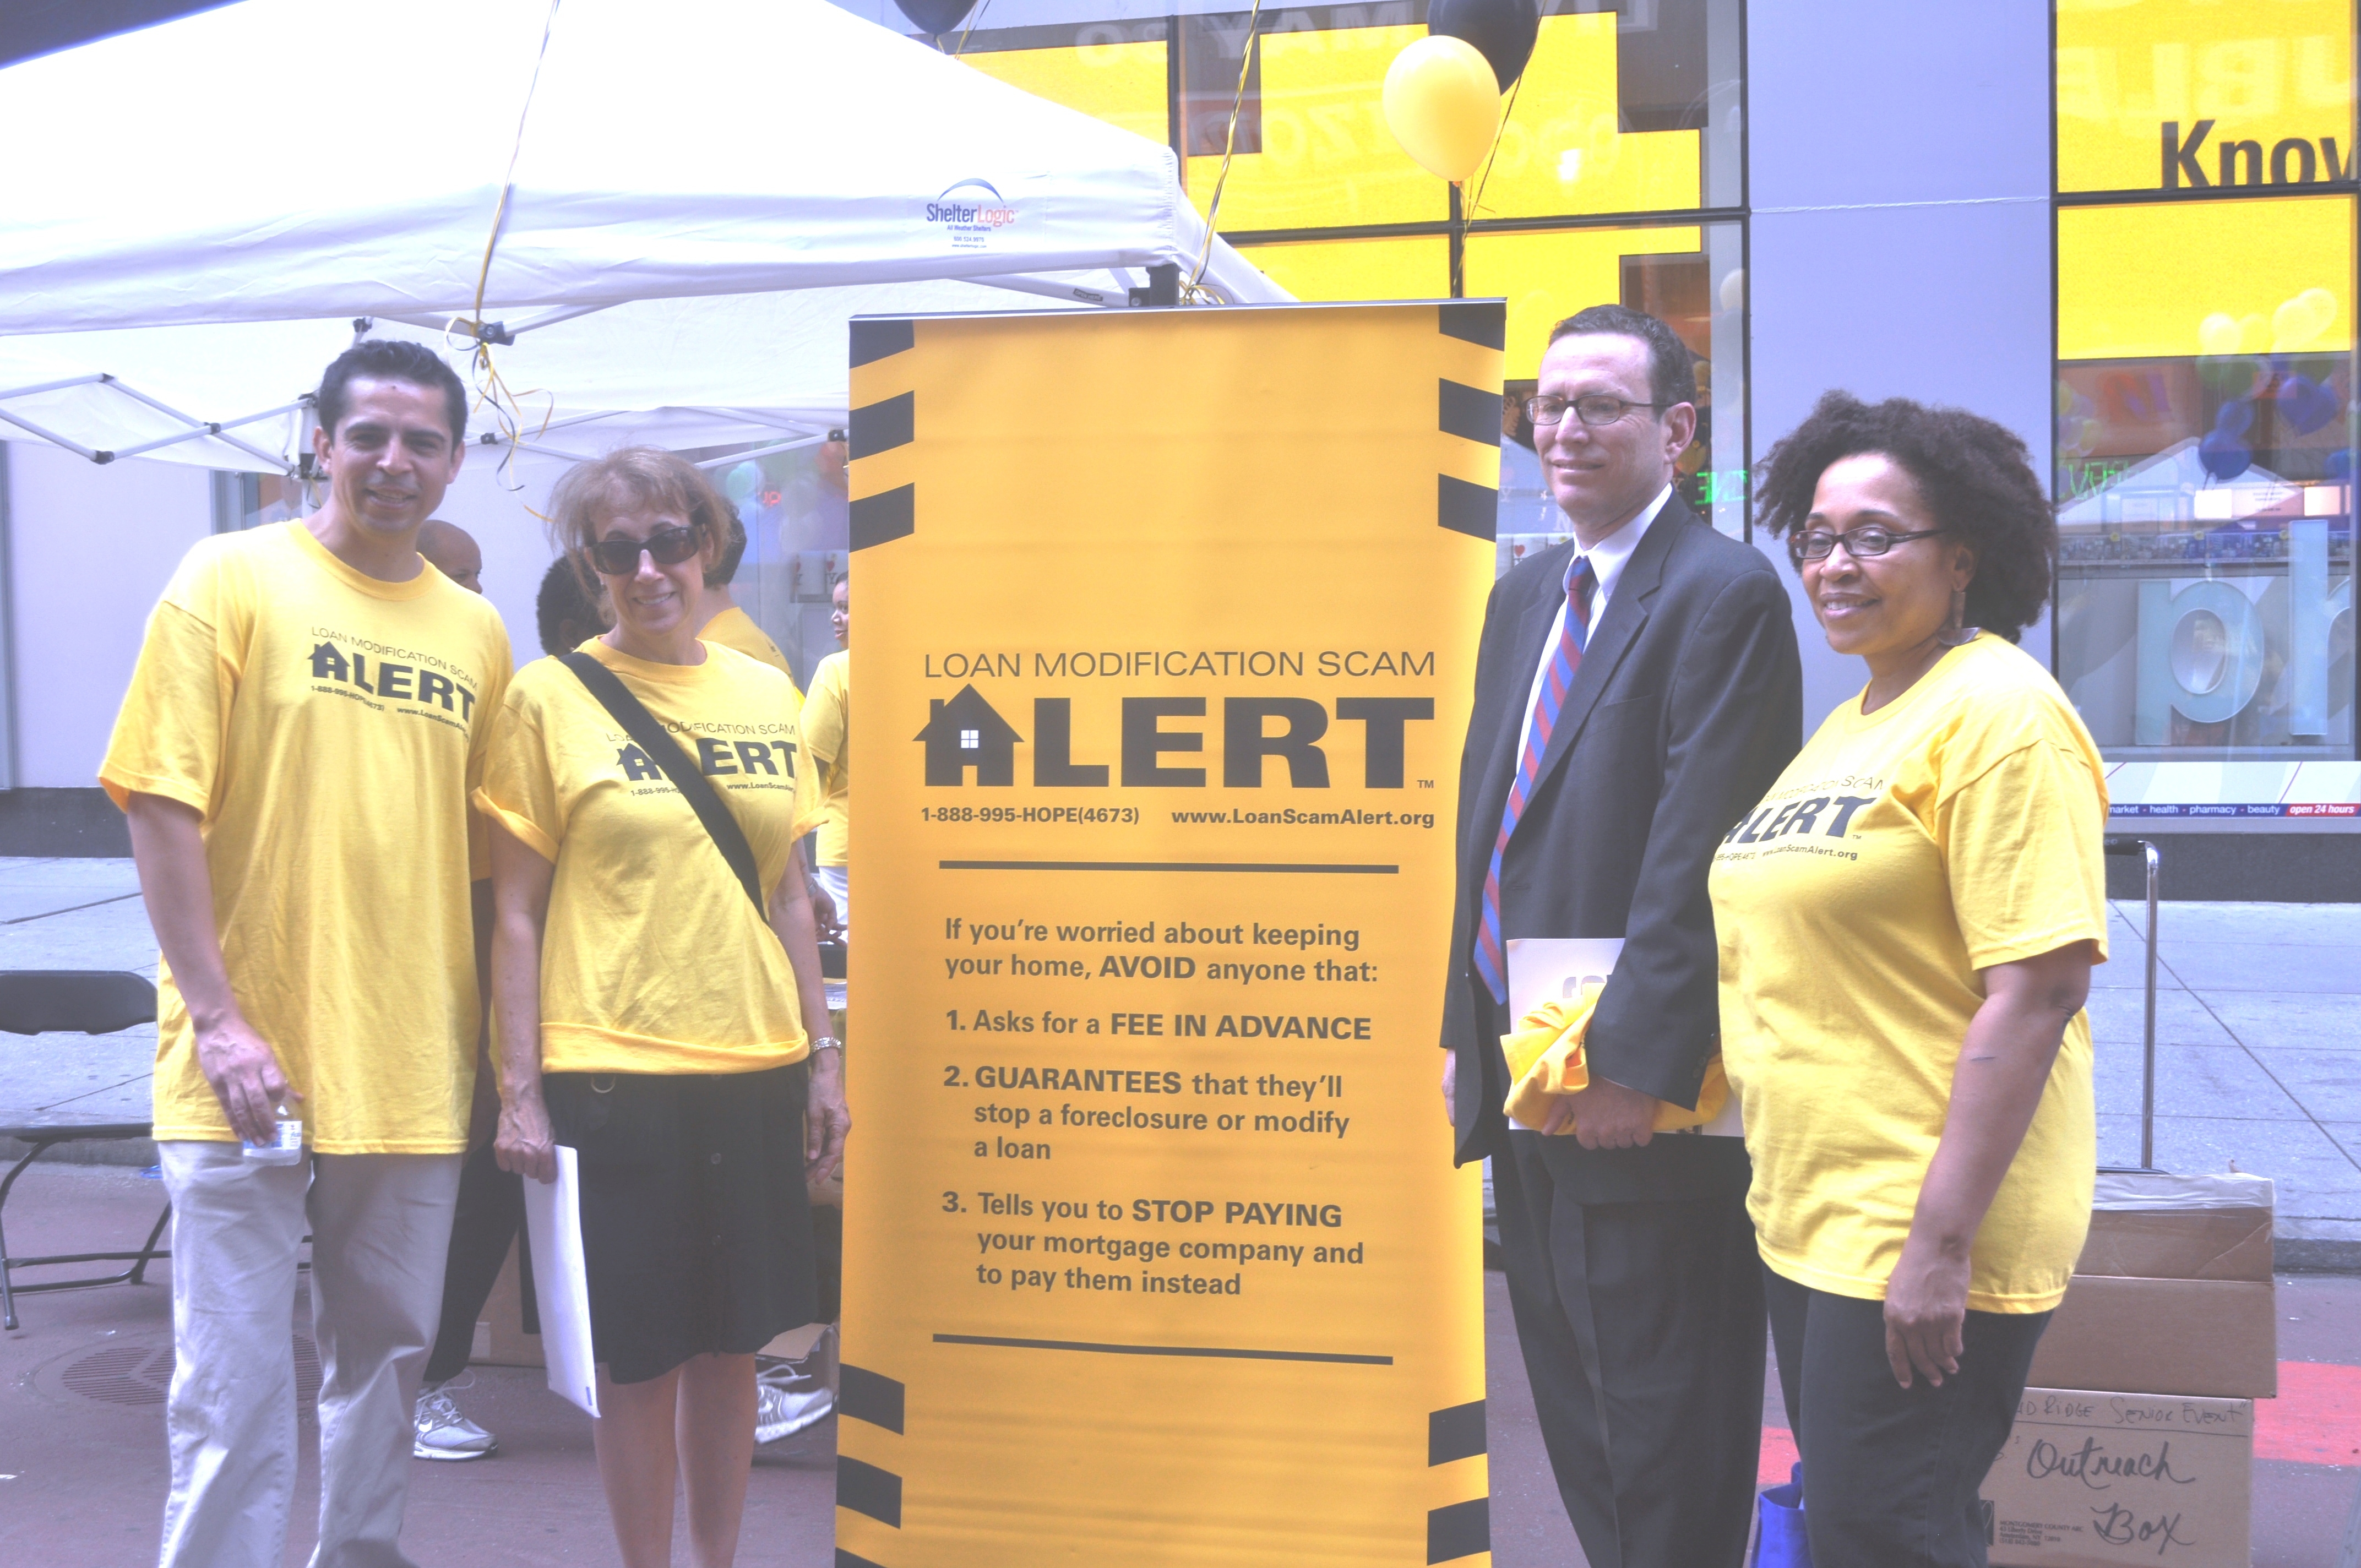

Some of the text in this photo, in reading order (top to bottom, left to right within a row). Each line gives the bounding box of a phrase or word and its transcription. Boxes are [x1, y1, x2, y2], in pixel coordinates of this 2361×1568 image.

[927, 203, 1014, 227] ShelterLogic
[312, 627, 477, 690] LOAN MODIFICATION SCAM
[926, 651, 1434, 678] LOAN MODIFICATION SCAM
[308, 641, 475, 722] ALERT
[661, 721, 756, 734] ODIFICATION
[759, 723, 796, 735] SCAM
[912, 683, 1435, 789] ALERT
[616, 738, 797, 781] AERT
[922, 807, 1434, 829] 1-888-995-HOPE(4673) www.LoanScamAlert.org
[1724, 796, 1877, 843] ALERT
[2150, 805, 2178, 814] health
[2190, 805, 2236, 815] pharmacy
[2247, 805, 2280, 815] beauty
[2290, 806, 2312, 815] open
[2314, 805, 2326, 814] 24
[2328, 805, 2354, 814] hours
[946, 918, 1359, 951] If you’re worried about keeping
[945, 954, 1377, 985] your home, AVOID anyone that:
[946, 1010, 1370, 1039] 1. Asks for a FEE IN ADVANCE
[944, 1065, 1341, 1102] 2. GUARANTEES that they’ll
[975, 1103, 1350, 1139] stop a foreclosure or modify
[975, 1136, 1050, 1159] a loan
[942, 1191, 1341, 1227] 3. Tells you to STOP PAYING
[977, 1233, 1363, 1267] your mortgage company and
[976, 1264, 1240, 1294] to pay them instead
[2027, 1436, 2196, 1490] Outreach
[2090, 1502, 2196, 1555] Box
